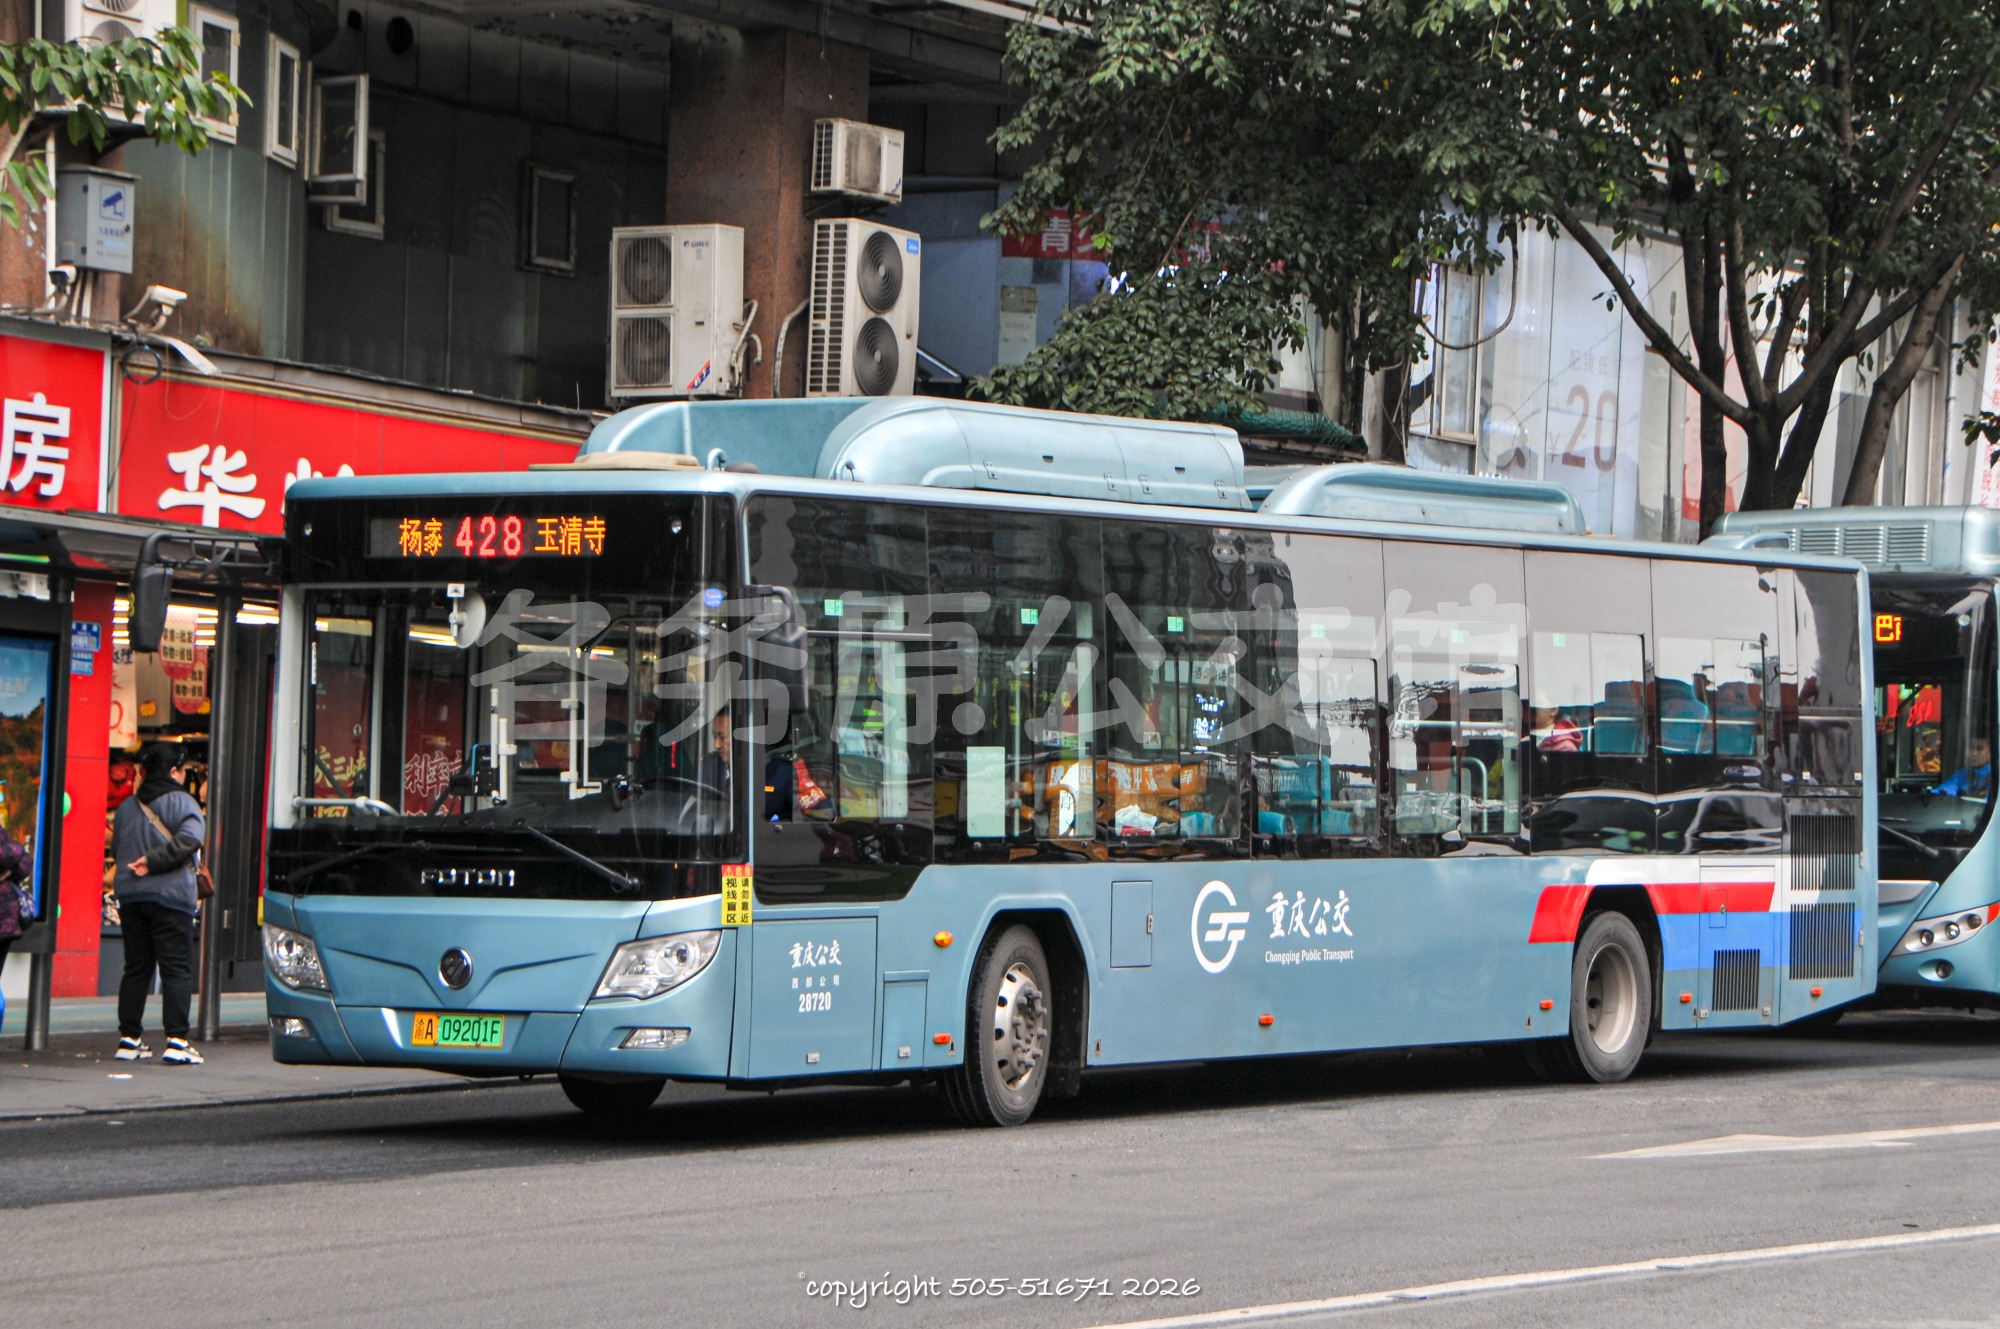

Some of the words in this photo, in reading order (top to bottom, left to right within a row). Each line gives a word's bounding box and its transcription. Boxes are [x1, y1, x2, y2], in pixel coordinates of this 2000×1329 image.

[0, 392, 71, 497] 房
[399, 517, 443, 557] 杨家
[455, 515, 523, 557] 428
[535, 515, 606, 556] 玉清寺
[405, 749, 462, 800] 利率
[421, 868, 515, 887] FOTON
[1265, 889, 1353, 939] 重庆公交
[789, 940, 842, 968] 重庆公交
[1265, 950, 1300, 965] Chongqing
[1301, 949, 1321, 962] Public
[1322, 949, 1354, 963] Transport
[799, 991, 831, 1012] 28720
